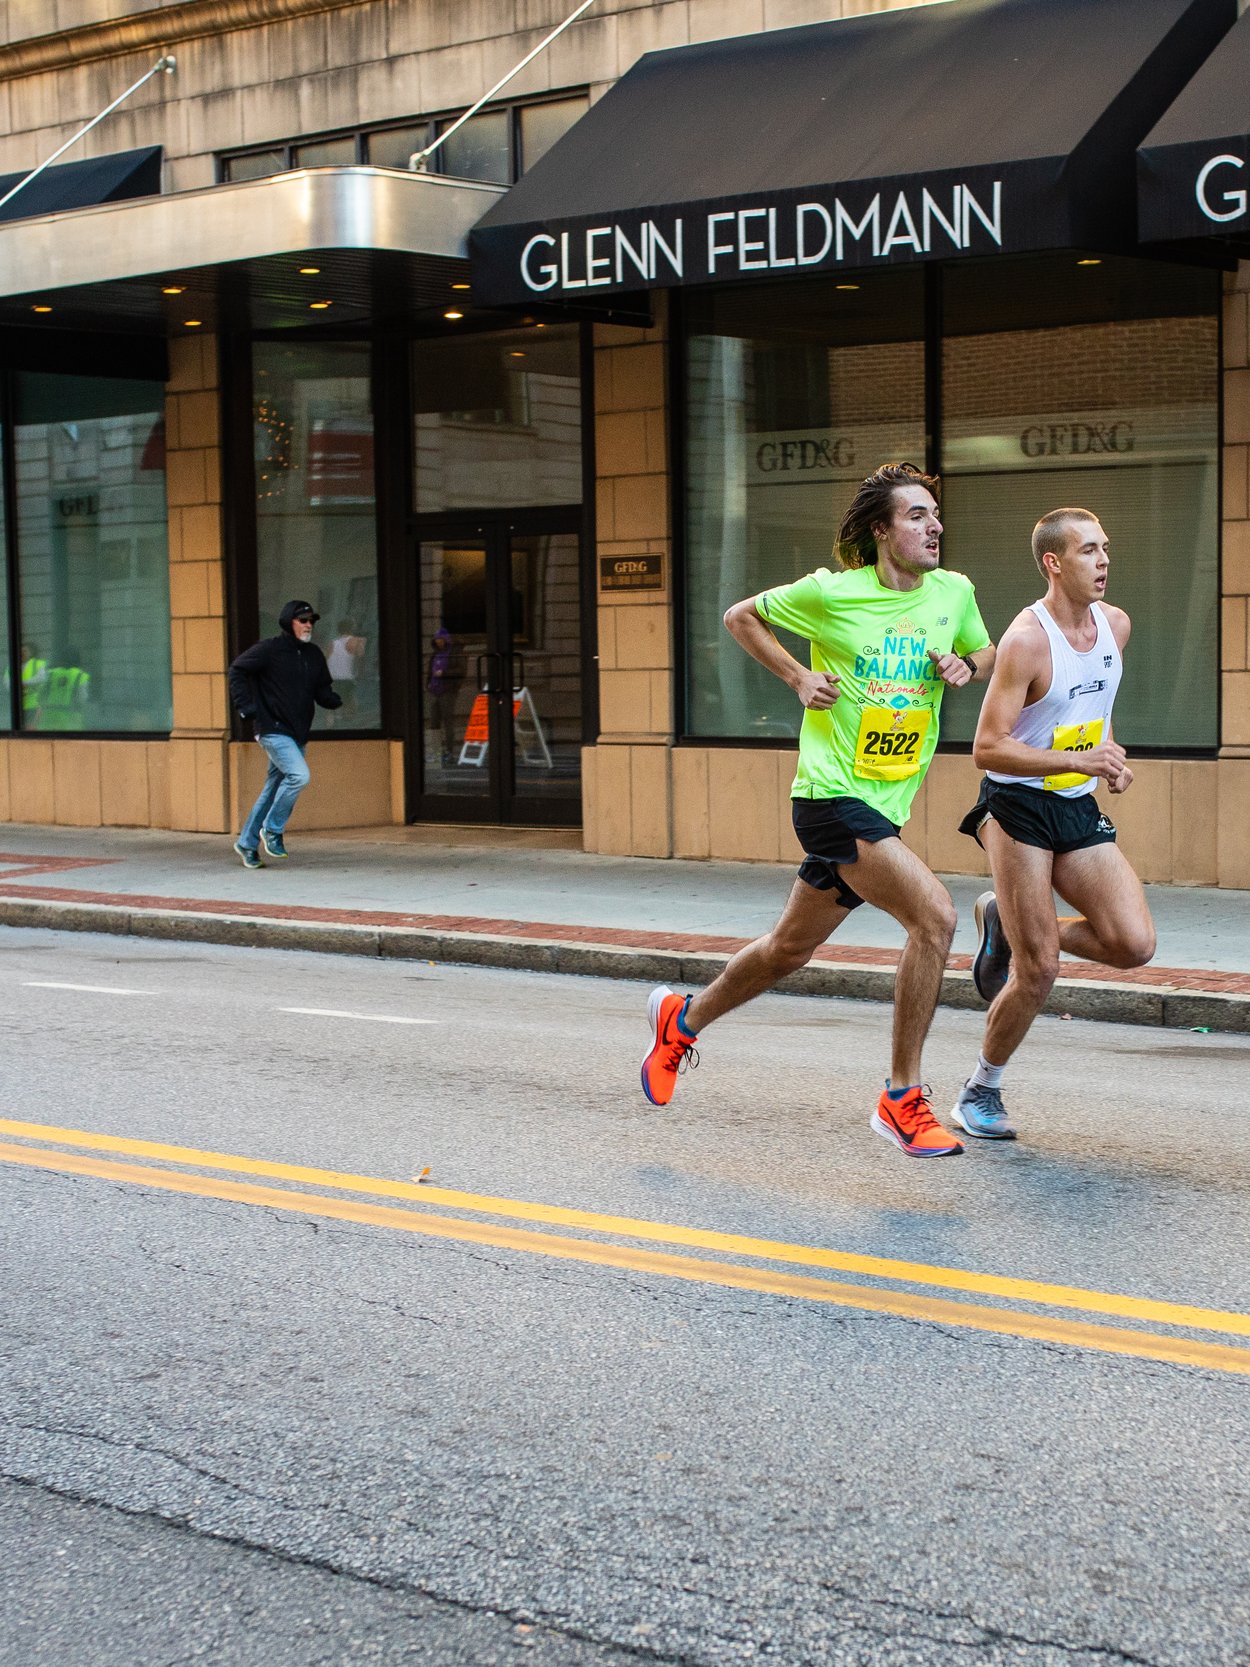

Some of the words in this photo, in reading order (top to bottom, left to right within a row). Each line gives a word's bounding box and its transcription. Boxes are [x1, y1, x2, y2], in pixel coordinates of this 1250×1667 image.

[520, 217, 683, 292] GLENN
[707, 181, 1003, 274] FELDMANN
[755, 436, 856, 473] GFD&G
[1020, 420, 1134, 458] GFD&G
[883, 636, 926, 657] NEW
[866, 680, 929, 697] Nationals
[863, 731, 920, 756] 2522
